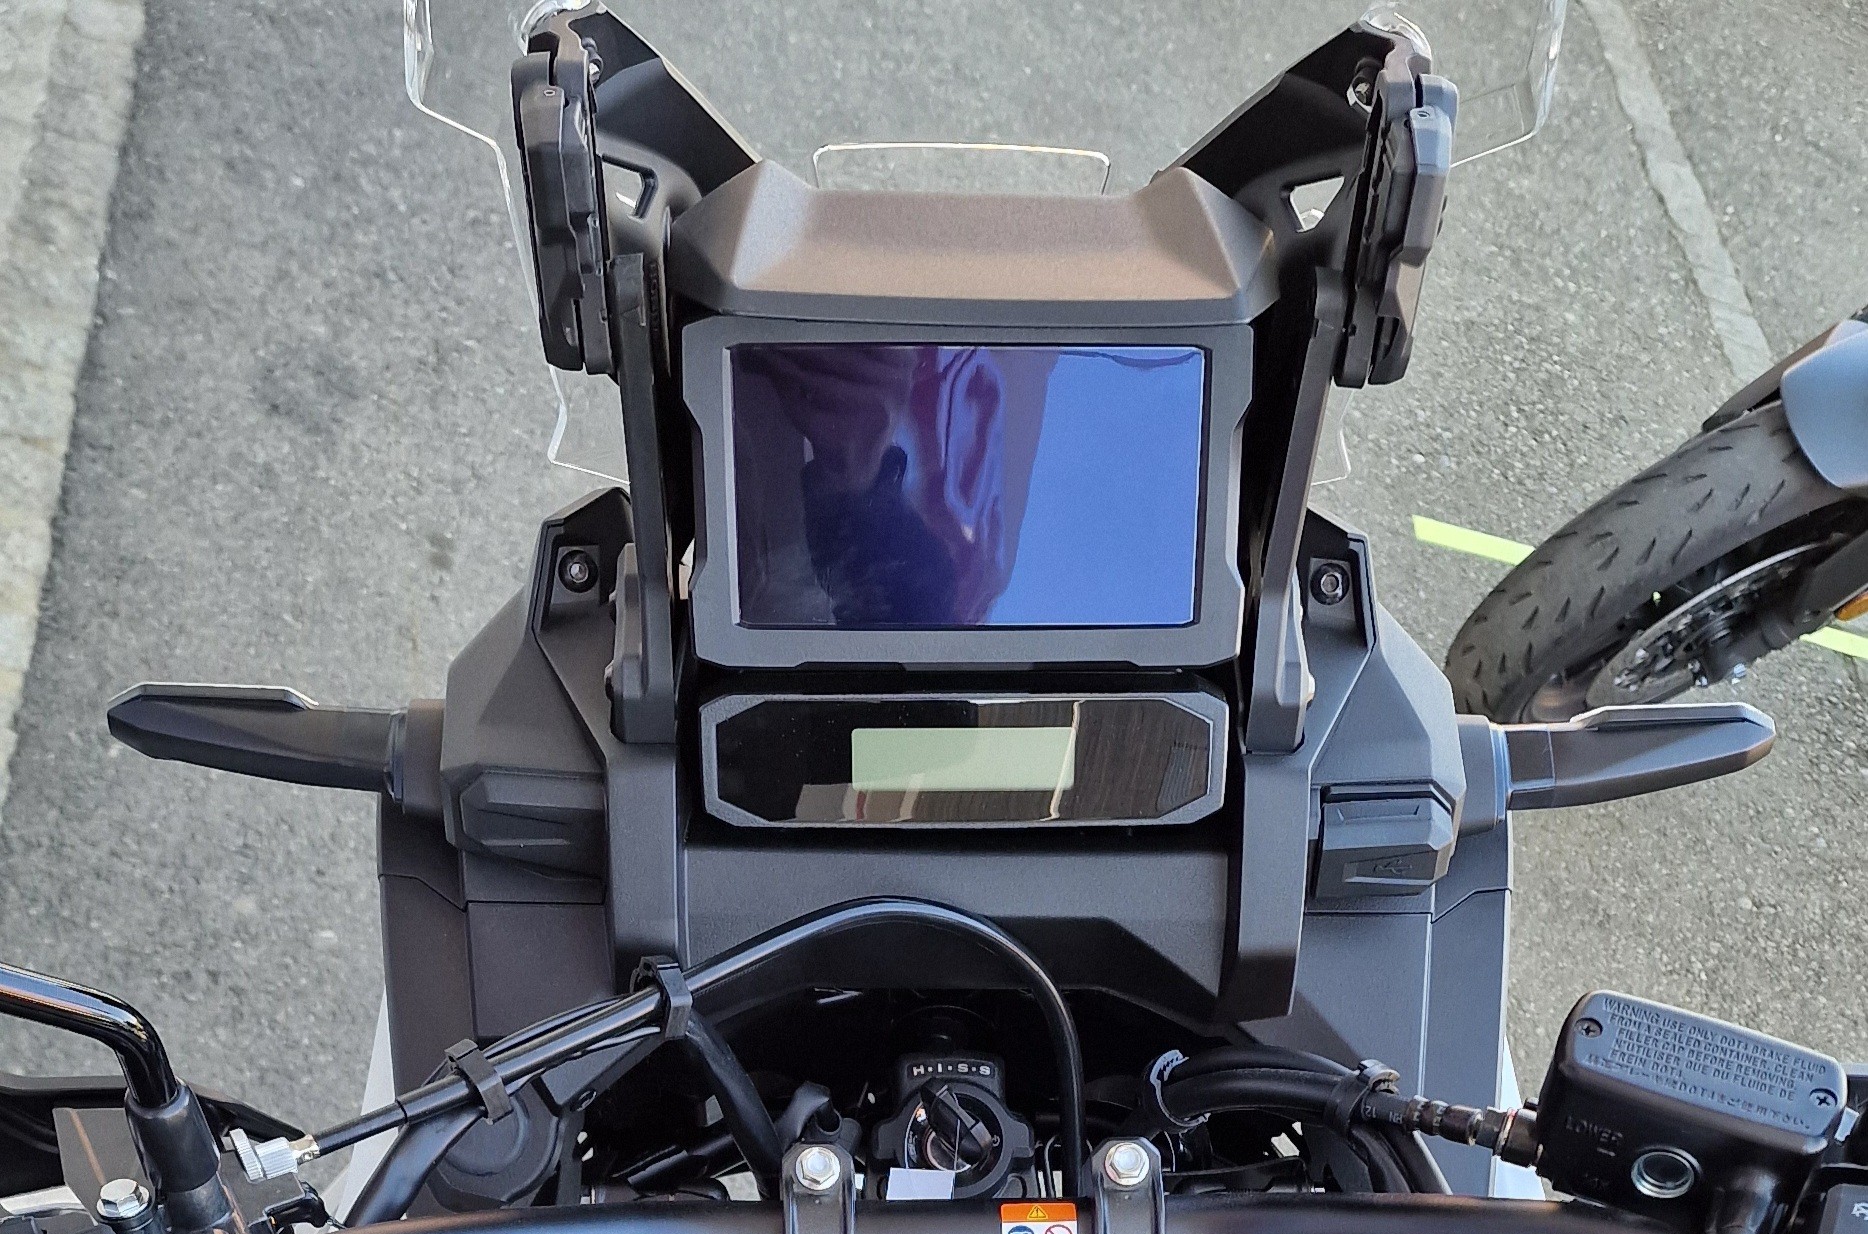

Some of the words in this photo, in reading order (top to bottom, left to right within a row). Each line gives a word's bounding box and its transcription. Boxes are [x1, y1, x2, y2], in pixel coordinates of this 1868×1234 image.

[1602, 998, 1661, 1025] WARNING
[1662, 1018, 1687, 1033] USE
[1688, 1026, 1718, 1042] ONLY
[1751, 1045, 1790, 1064] BRAKE
[1793, 1057, 1827, 1075] FLUID
[1609, 1013, 1642, 1031] FROM
[1654, 1027, 1702, 1049] SEALED
[1774, 1064, 1815, 1082] CLEAN
[1617, 1029, 1659, 1048] FILLER
[1686, 1049, 1734, 1071] BEFORE
[1609, 1049, 1647, 1068] FREIN
[1684, 1060, 1709, 1076] QUE
[1732, 1074, 1776, 1096] FLUIDE
